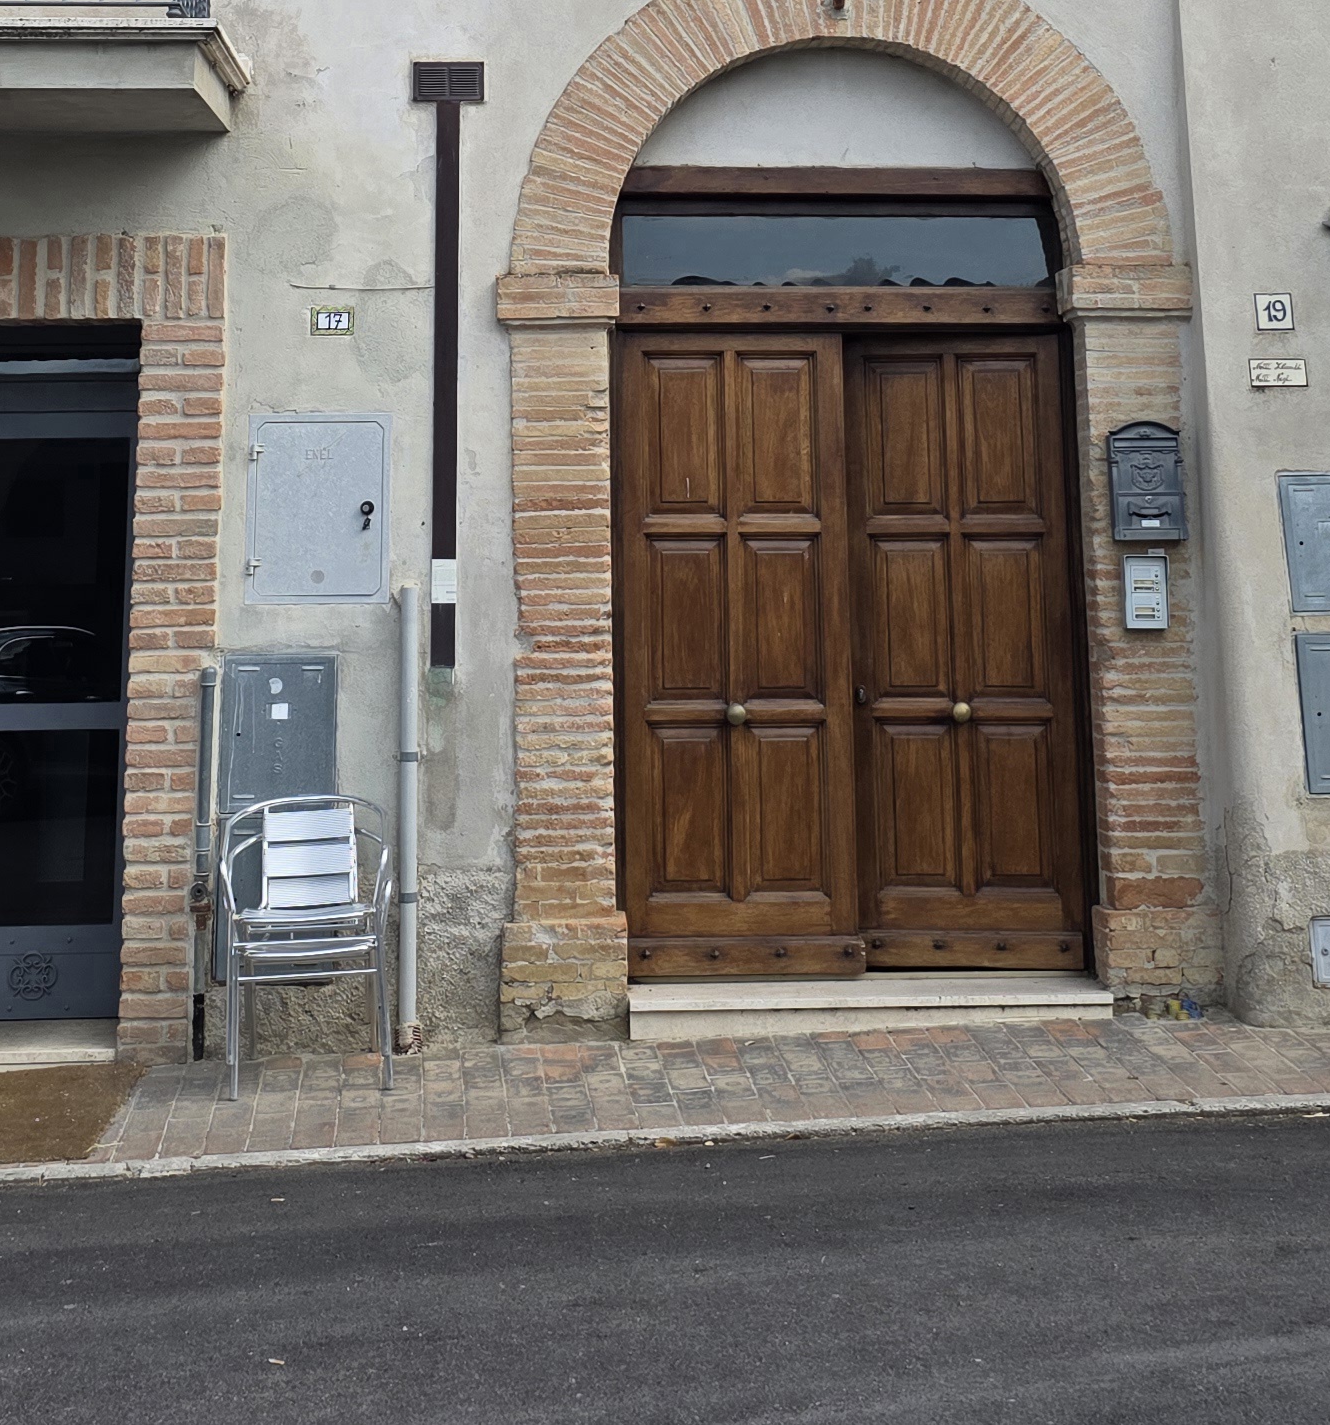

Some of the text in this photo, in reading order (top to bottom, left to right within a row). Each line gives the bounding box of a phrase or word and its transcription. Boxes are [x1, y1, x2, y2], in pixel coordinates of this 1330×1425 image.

[324, 312, 343, 330] 17
[1262, 299, 1287, 323] 19
[304, 448, 334, 461] ENEL
[273, 736, 284, 774] GAS
